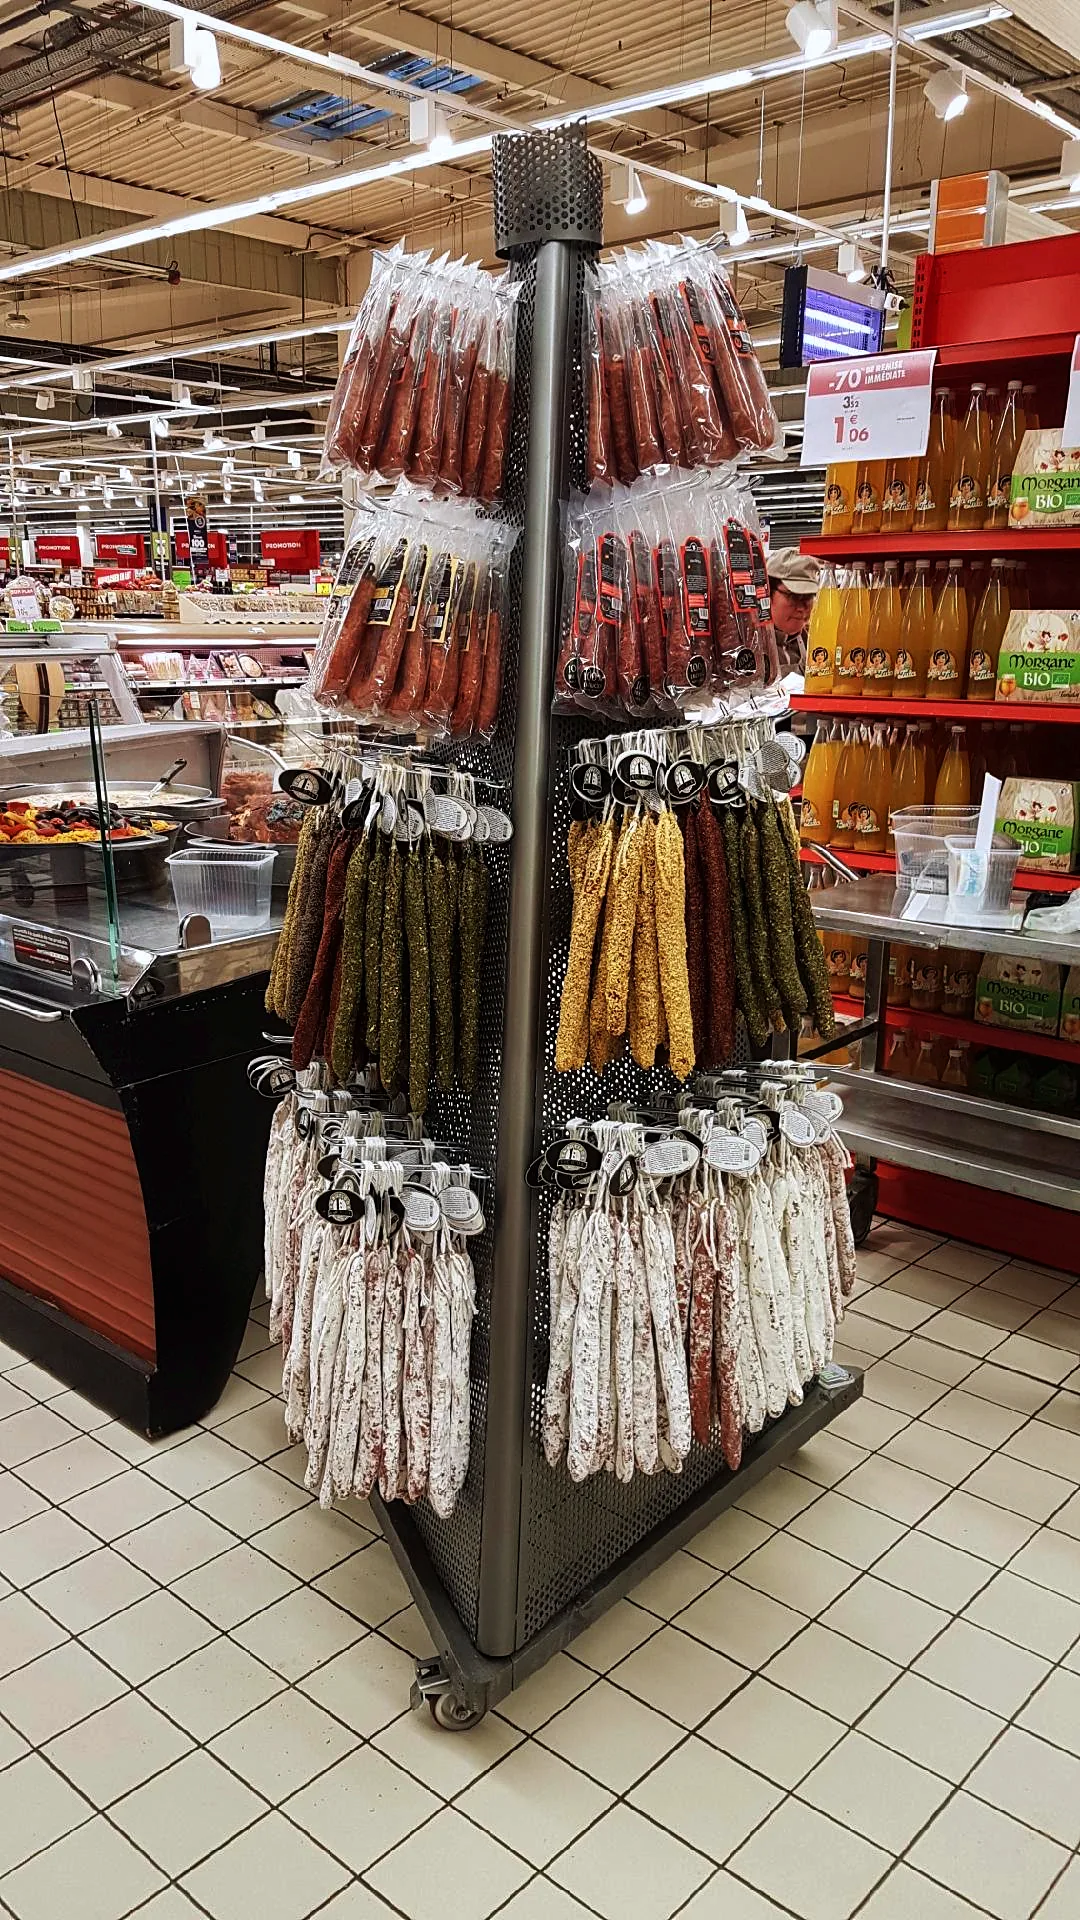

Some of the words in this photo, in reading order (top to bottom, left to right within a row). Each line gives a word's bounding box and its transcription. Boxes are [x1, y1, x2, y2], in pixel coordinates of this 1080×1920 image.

[875, 360, 903, 371] REMISE
[864, 370, 906, 384] IMMÉDIATE
[1022, 476, 1080, 492] Morgan
[1035, 494, 1062, 508] BIO
[1009, 654, 1075, 671] Morgane
[1023, 672, 1051, 686] BIO
[1002, 821, 1064, 840] Morgane
[986, 981, 1049, 1003] Morgane
[1000, 1000, 1025, 1014] BIO
